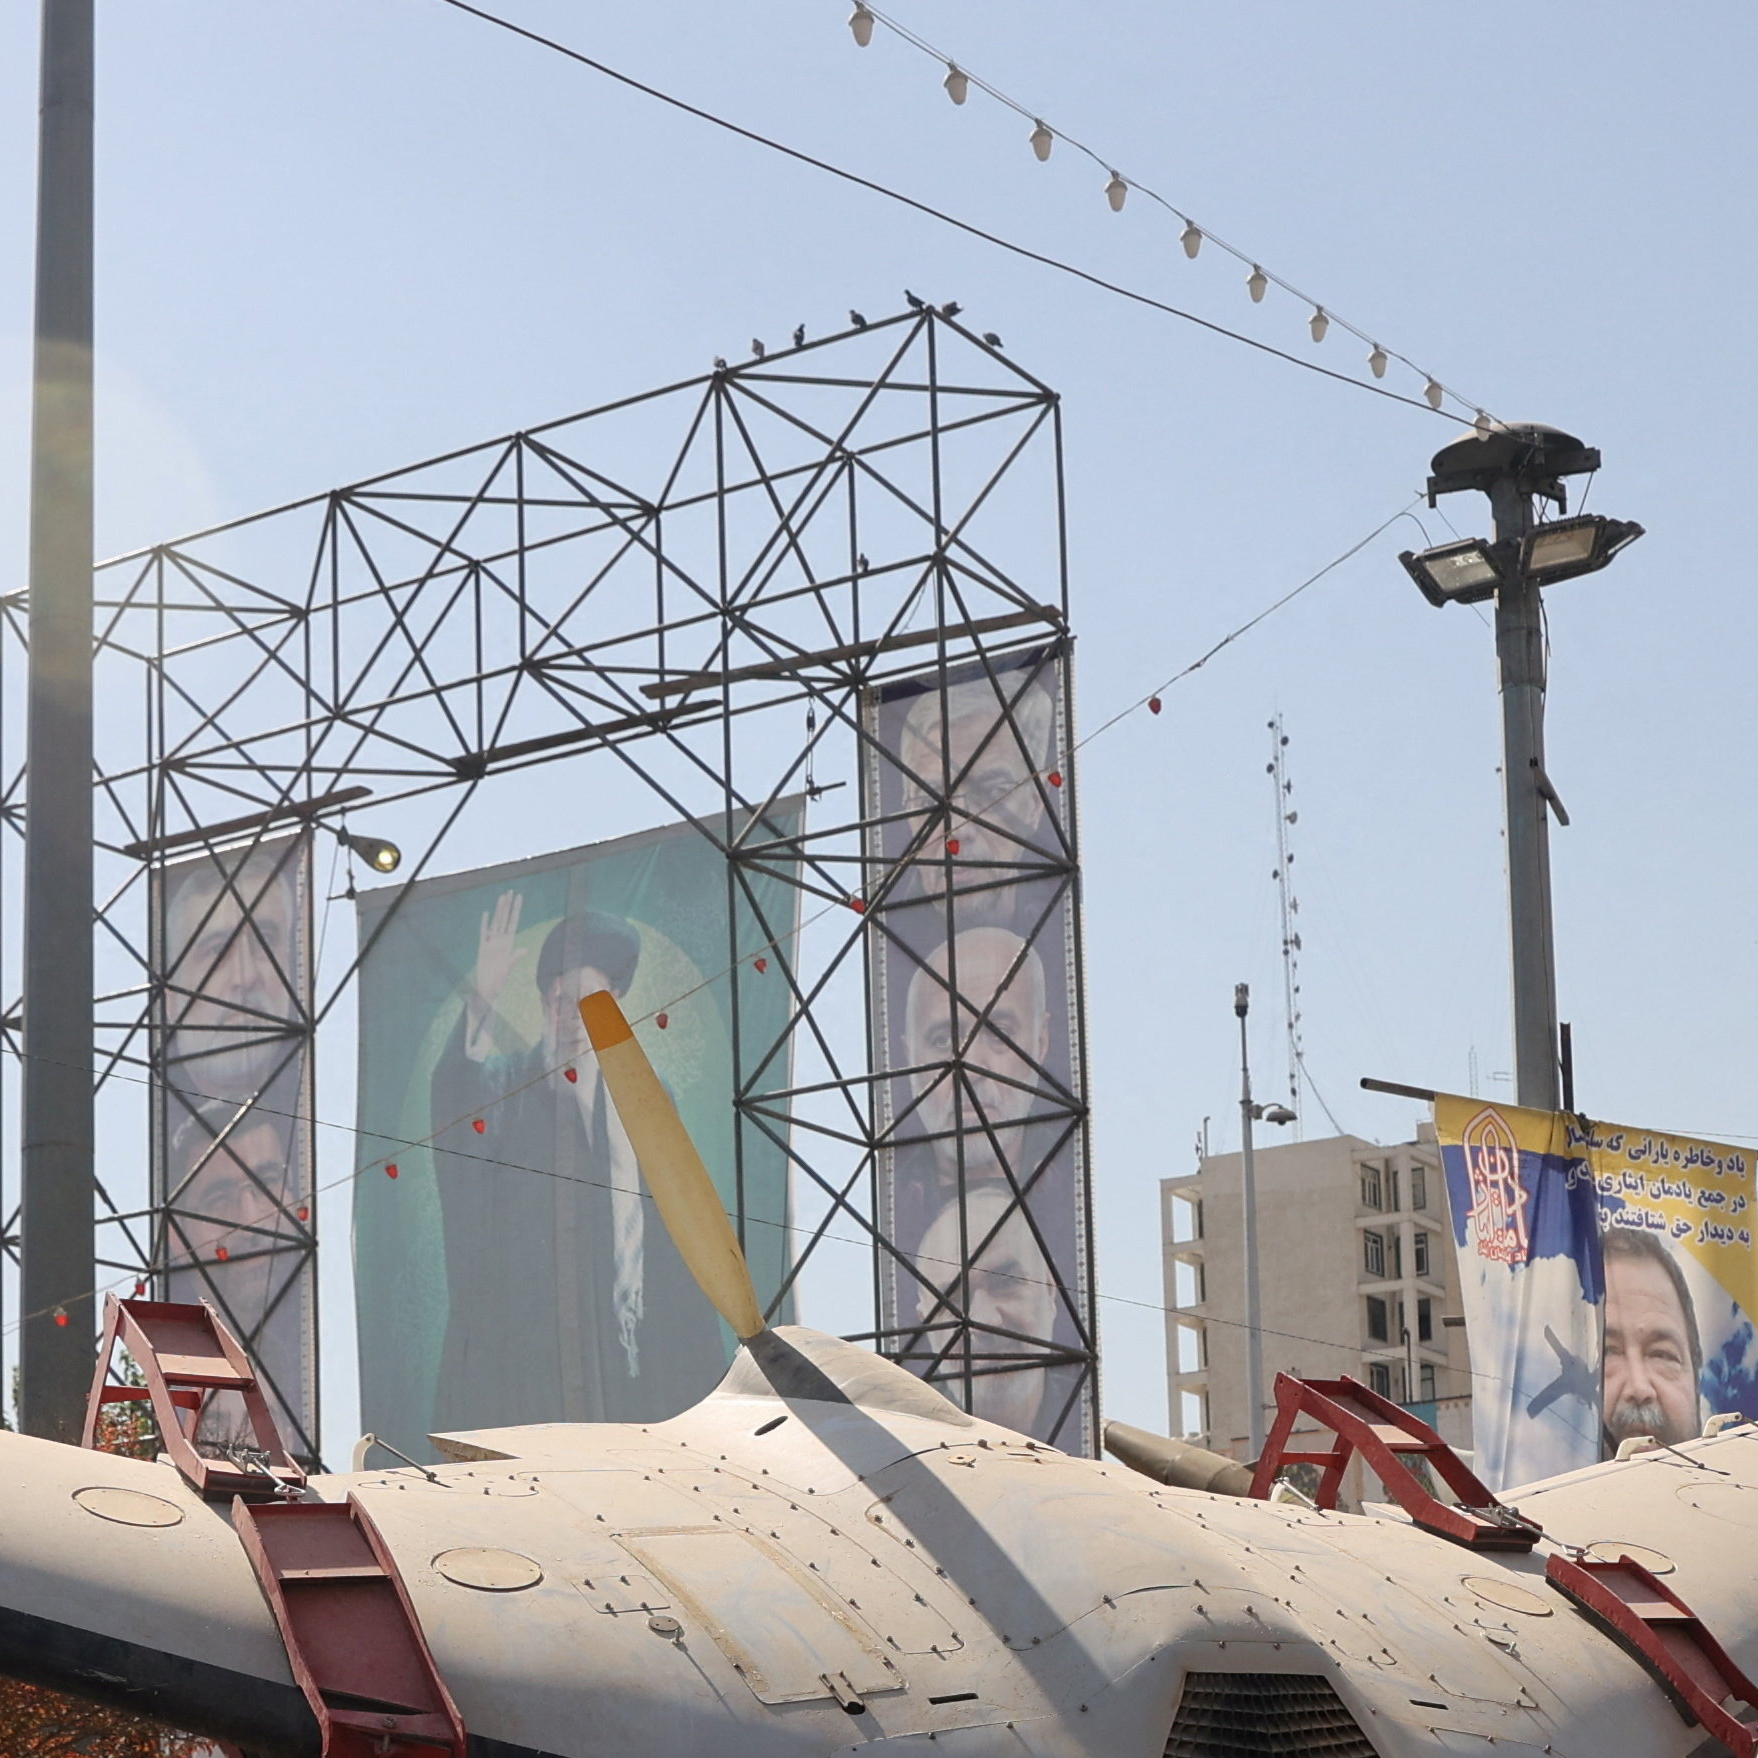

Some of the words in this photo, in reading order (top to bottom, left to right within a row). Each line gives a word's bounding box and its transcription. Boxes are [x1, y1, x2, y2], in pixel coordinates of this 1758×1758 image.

[1606, 1133, 1624, 1152] که
[1629, 1137, 1669, 1166] یارانی
[1726, 1154, 1745, 1178] یاد
[1598, 1171, 1645, 1196] ایثاری
[1650, 1177, 1692, 1205] یادمان
[1698, 1188, 1727, 1210] جمع
[1731, 1193, 1746, 1213] در
[1615, 1206, 1667, 1232] شتافتند
[1671, 1217, 1692, 1239] حق
[1698, 1220, 1734, 1245] دیدار
[1739, 1229, 1750, 1250] به
